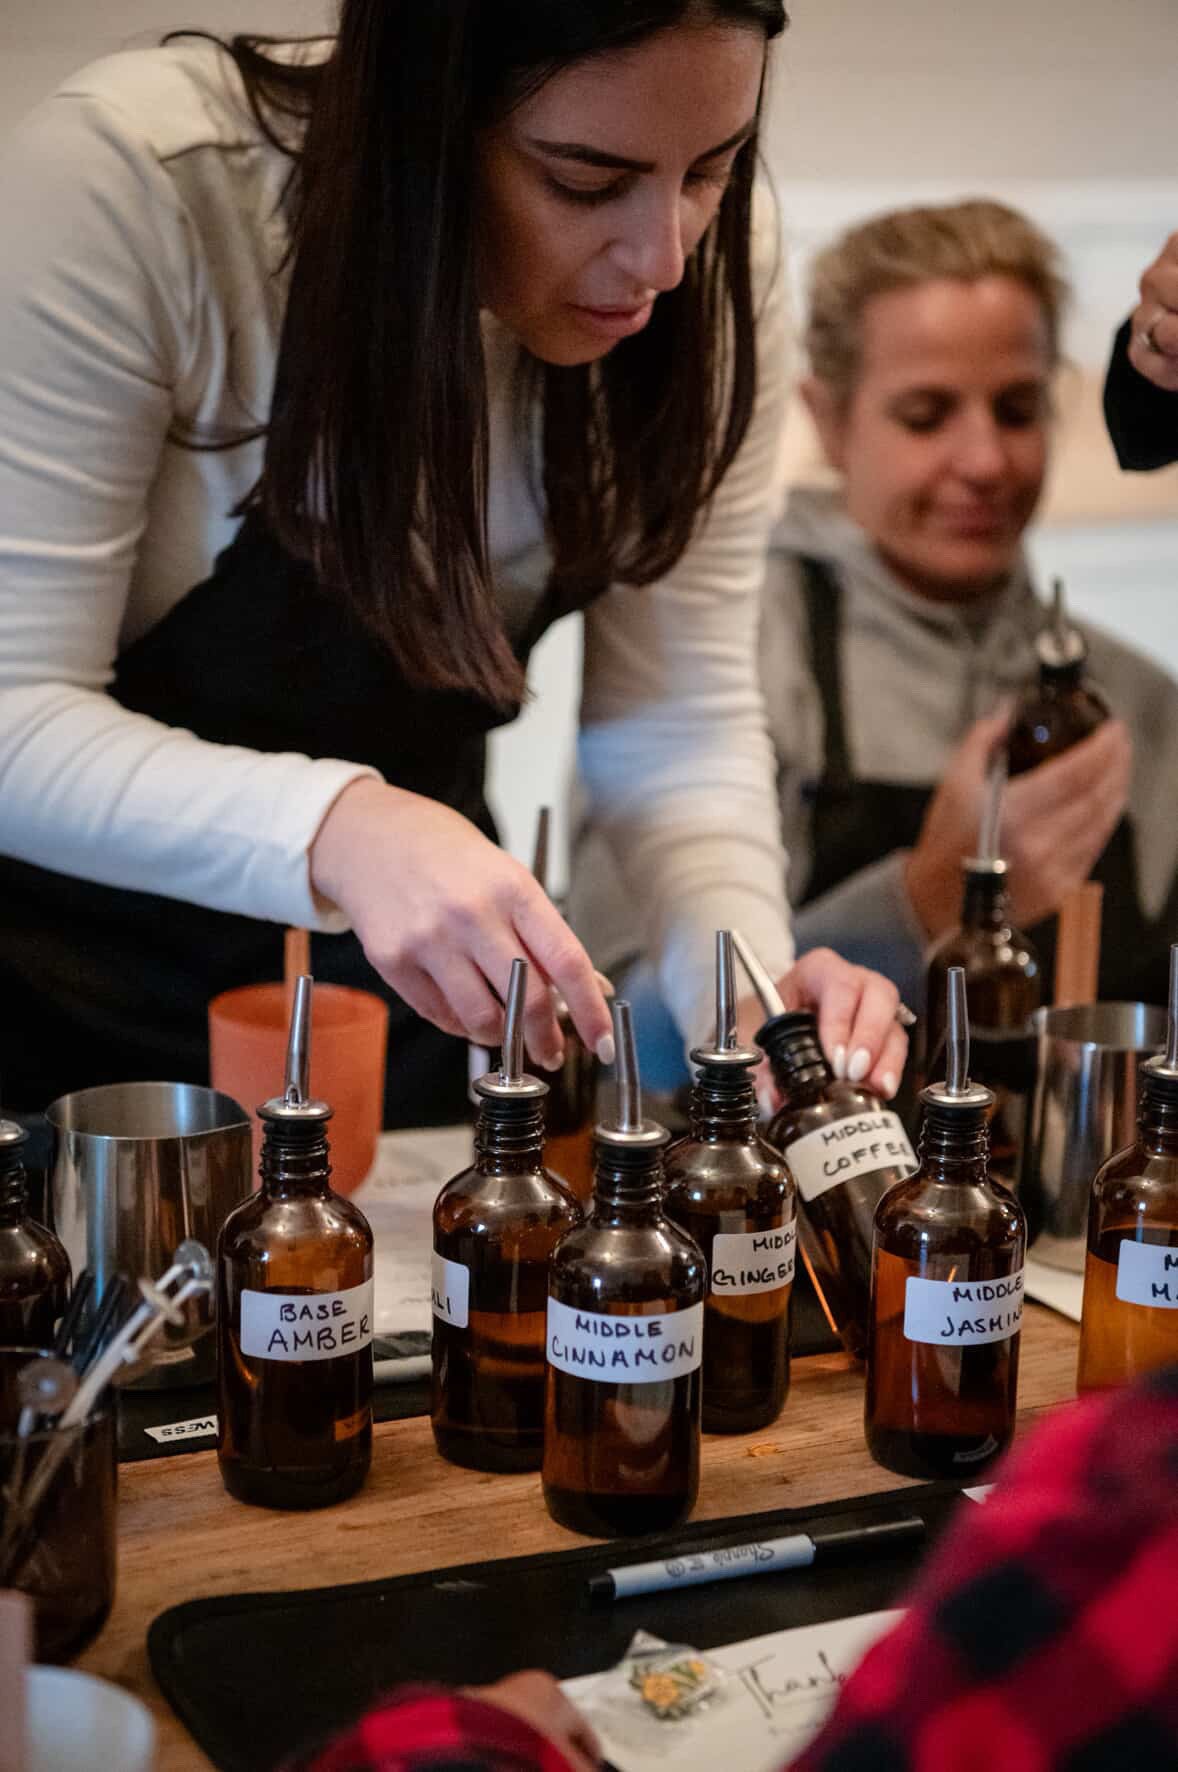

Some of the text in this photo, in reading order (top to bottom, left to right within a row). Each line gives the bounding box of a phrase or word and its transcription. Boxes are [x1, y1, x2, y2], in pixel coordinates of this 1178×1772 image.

[821, 1118, 893, 1147] MIDDLE
[952, 1275, 1022, 1304] MIDDLE
[279, 1299, 348, 1322] BASE
[266, 1314, 371, 1352] AMBER
[575, 1314, 663, 1338] MIDDLE
[551, 1335, 695, 1368] CINNAMON
